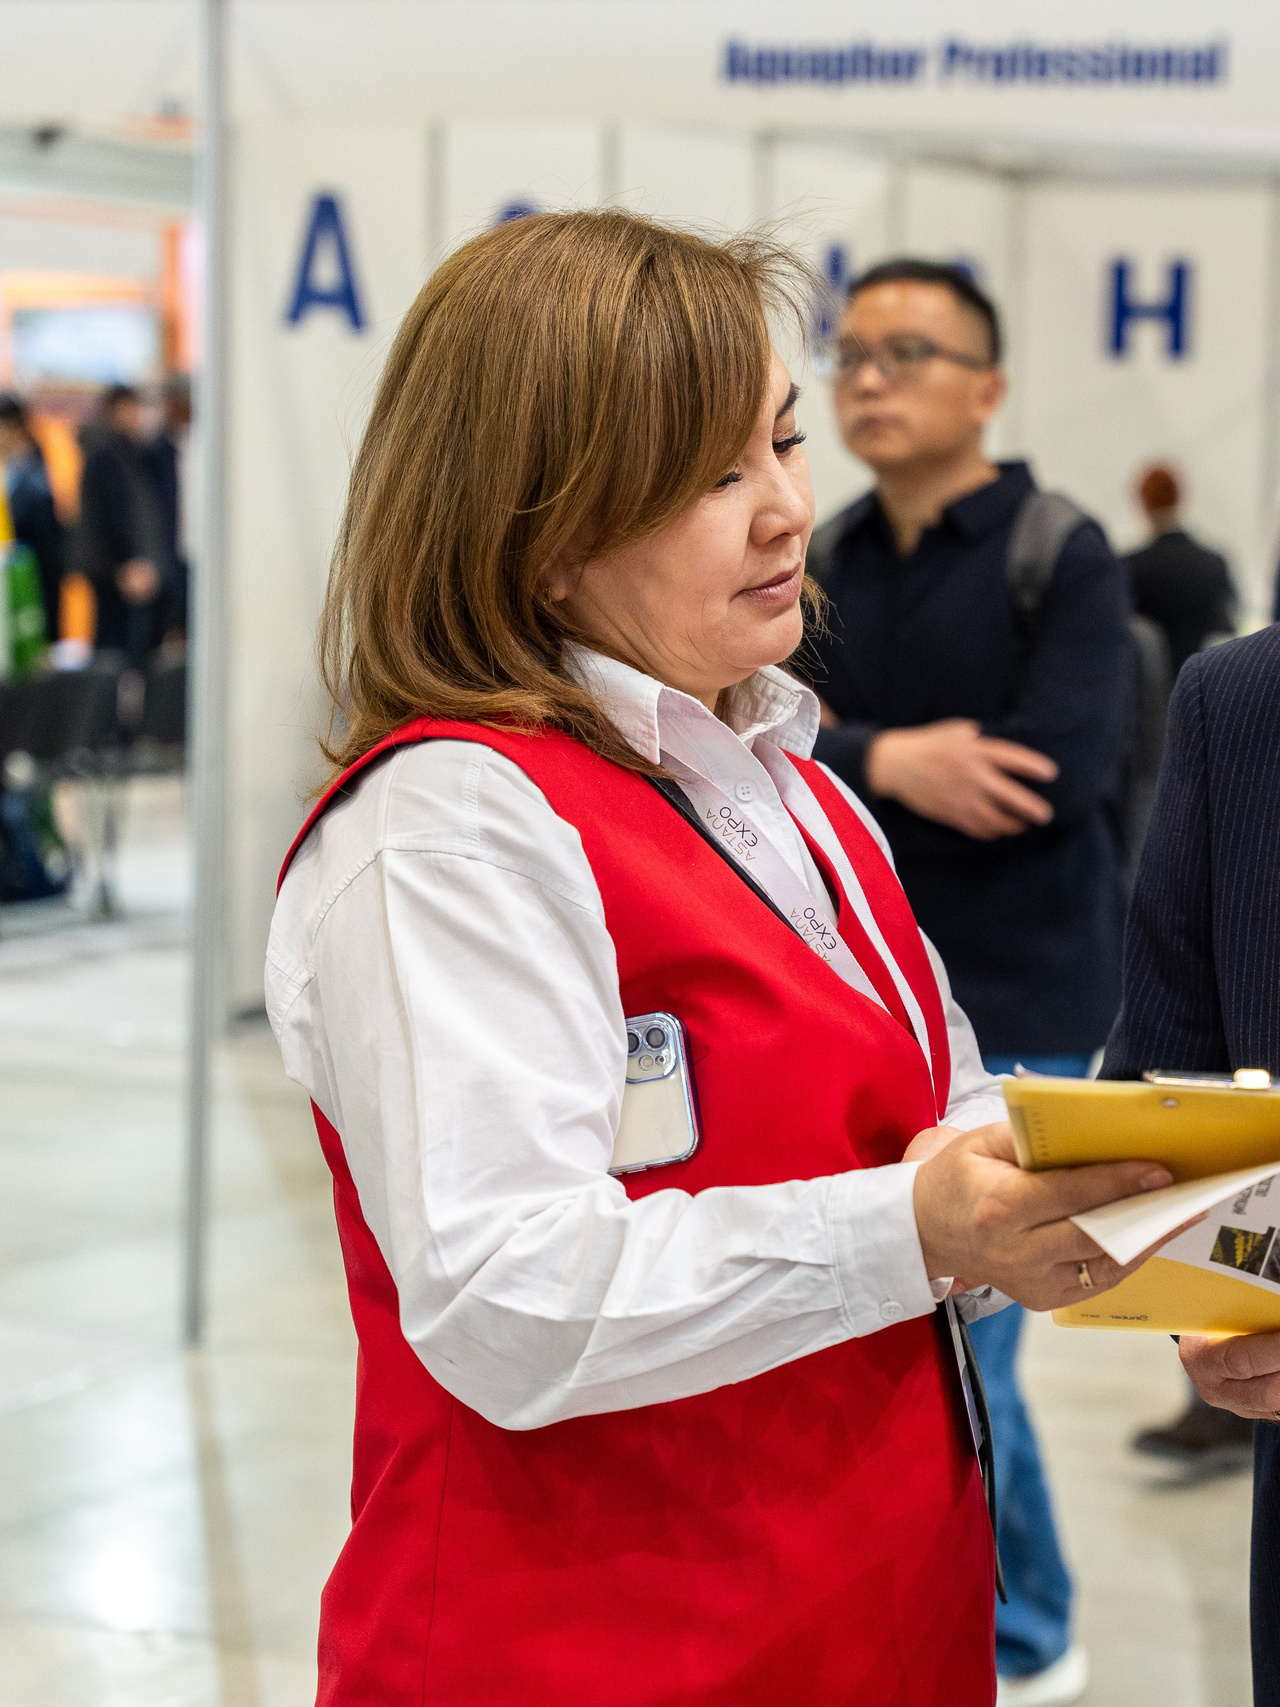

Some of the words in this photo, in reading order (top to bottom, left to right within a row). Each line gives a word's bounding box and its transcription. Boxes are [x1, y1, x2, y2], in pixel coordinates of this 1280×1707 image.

[941, 37, 1226, 86] Professional
[706, 808, 756, 861] ASTANA
[719, 806, 758, 847] EXPO
[803, 907, 837, 950] EXPO
